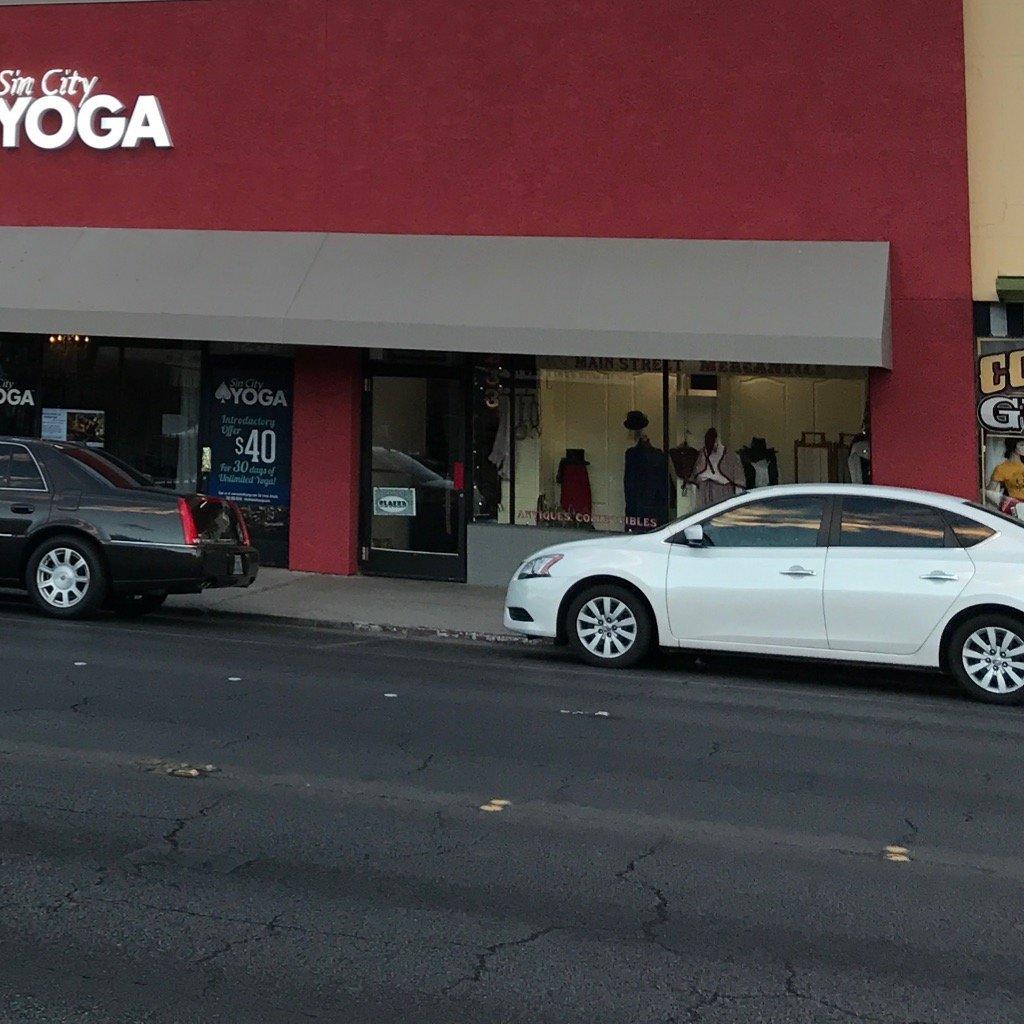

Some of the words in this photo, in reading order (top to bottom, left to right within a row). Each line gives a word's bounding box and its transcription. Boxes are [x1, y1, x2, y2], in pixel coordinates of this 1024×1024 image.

[41, 68, 99, 108] City
[619, 359, 683, 373] STRET
[229, 378, 244, 388] Sin
[245, 378, 265, 391] City
[229, 387, 288, 407] YOGA
[978, 396, 1024, 431] G
[221, 415, 276, 429] Introductory
[221, 425, 242, 437] Offer
[235, 429, 276, 463] $40
[220, 463, 232, 472] For
[232, 460, 249, 473] 30
[249, 466, 267, 476] days
[267, 466, 276, 477] of
[219, 473, 254, 484] Unlimited
[255, 476, 277, 487] Yoga!
[575, 513, 658, 527] COIBLES
